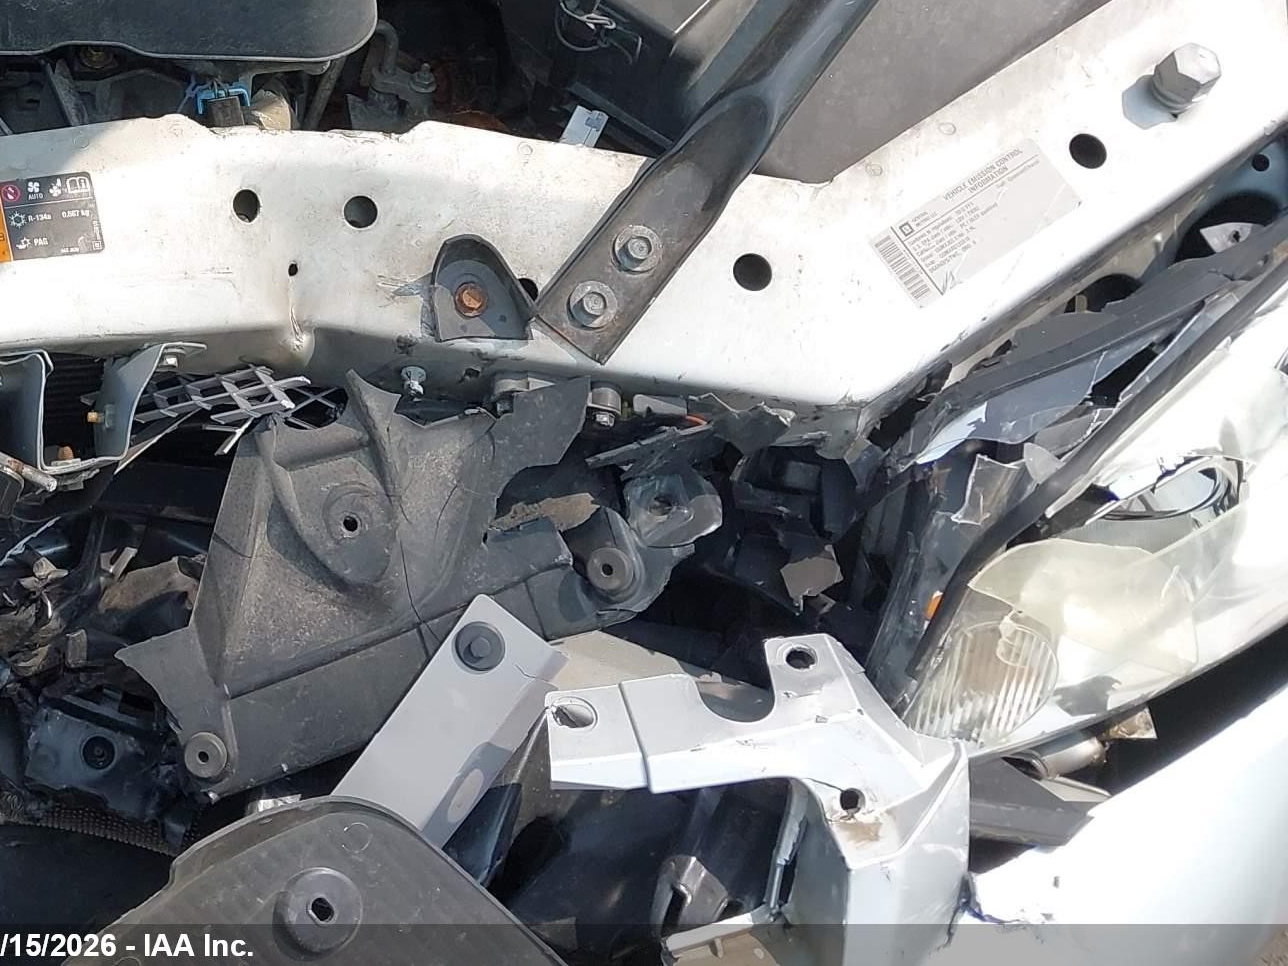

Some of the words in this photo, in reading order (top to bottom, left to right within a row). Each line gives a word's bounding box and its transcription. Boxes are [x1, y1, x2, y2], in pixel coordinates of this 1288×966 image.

[943, 182, 968, 201] VEHICLE
[967, 163, 996, 185] EMISSION
[995, 147, 1023, 167] CONTROL
[968, 166, 1008, 194] INFORMATION
[33, 237, 49, 246] PAG
